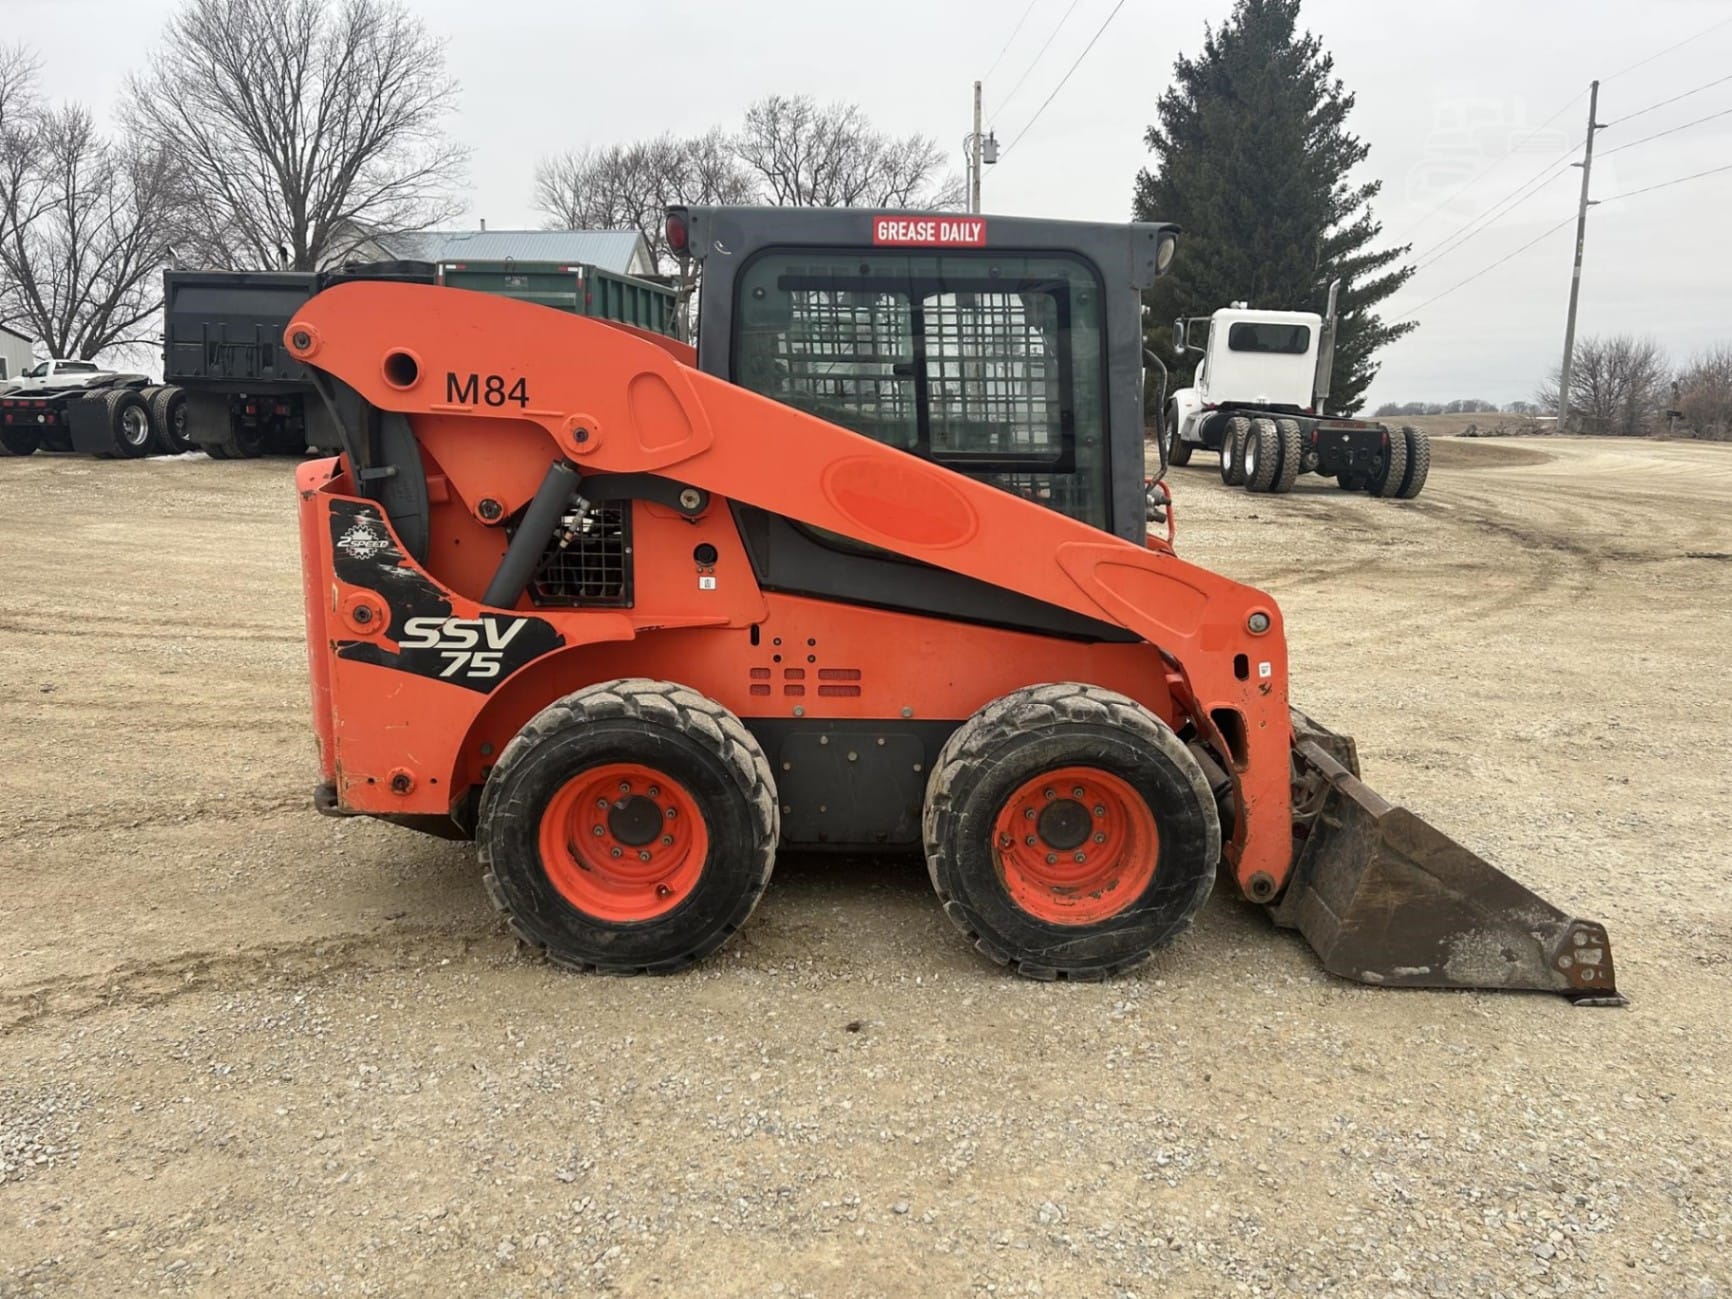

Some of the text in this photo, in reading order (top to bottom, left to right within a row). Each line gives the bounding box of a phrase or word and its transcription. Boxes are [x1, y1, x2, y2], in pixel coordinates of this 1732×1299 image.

[878, 221, 981, 242] GREASE DAILY
[446, 372, 530, 408] M84
[398, 616, 528, 650] SSV
[439, 651, 504, 677] 75
